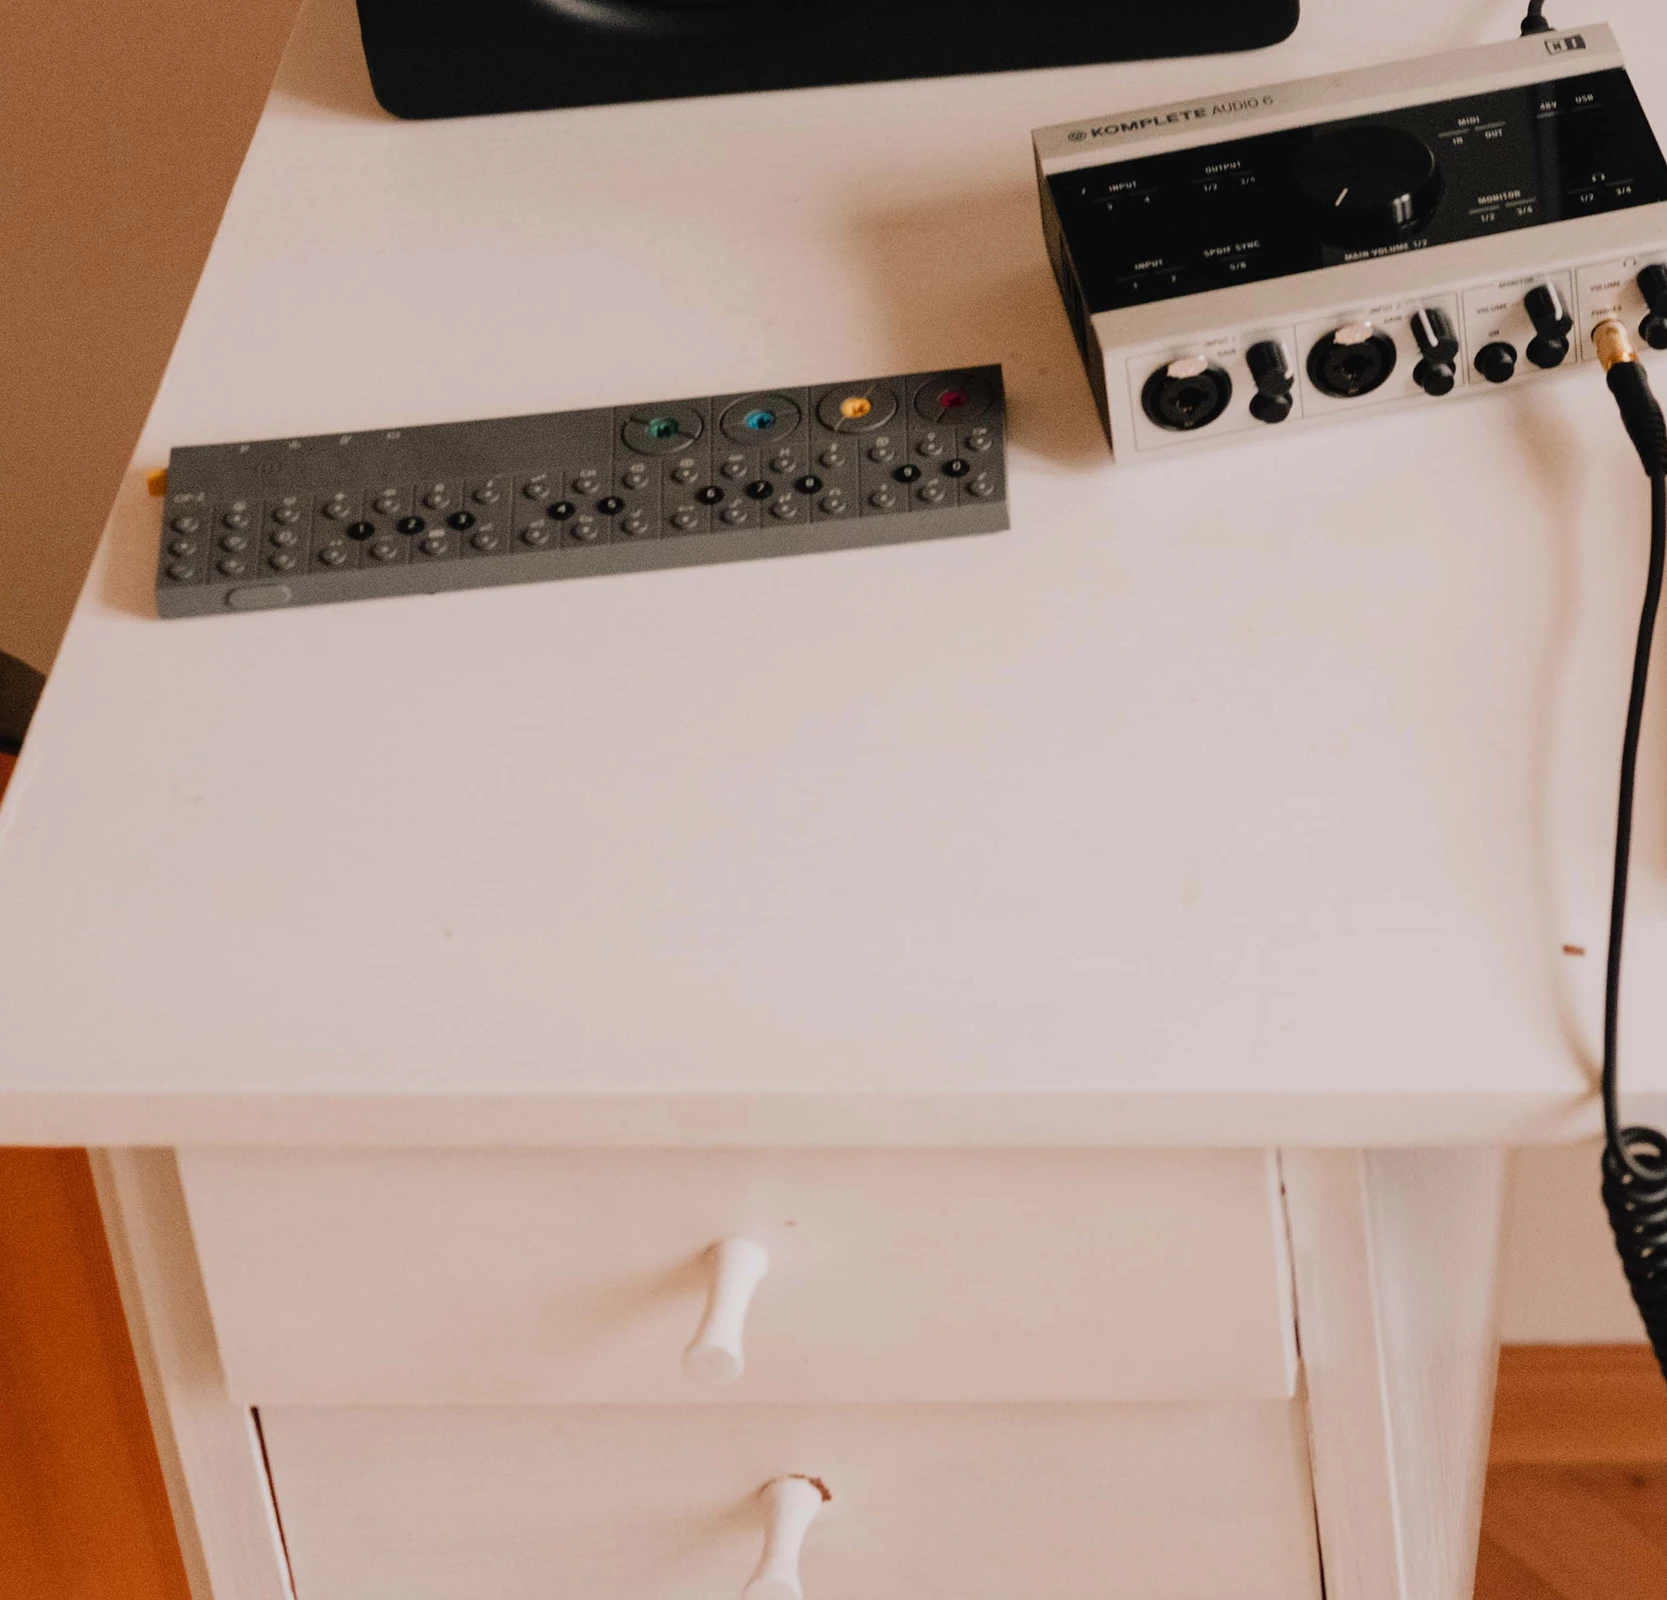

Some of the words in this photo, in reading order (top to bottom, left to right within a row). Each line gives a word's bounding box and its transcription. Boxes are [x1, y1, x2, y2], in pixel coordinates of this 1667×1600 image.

[1090, 107, 1207, 139] KOMPLETE
[1212, 97, 1259, 116] AUDIO
[1262, 95, 1274, 105] 6
[1458, 116, 1480, 127] MIDI
[1485, 128, 1503, 140] OUT
[1205, 161, 1241, 174] OUTPUT
[1109, 180, 1137, 193] INPUT
[1478, 190, 1521, 205] MONITOR
[1135, 258, 1163, 271] INPUT
